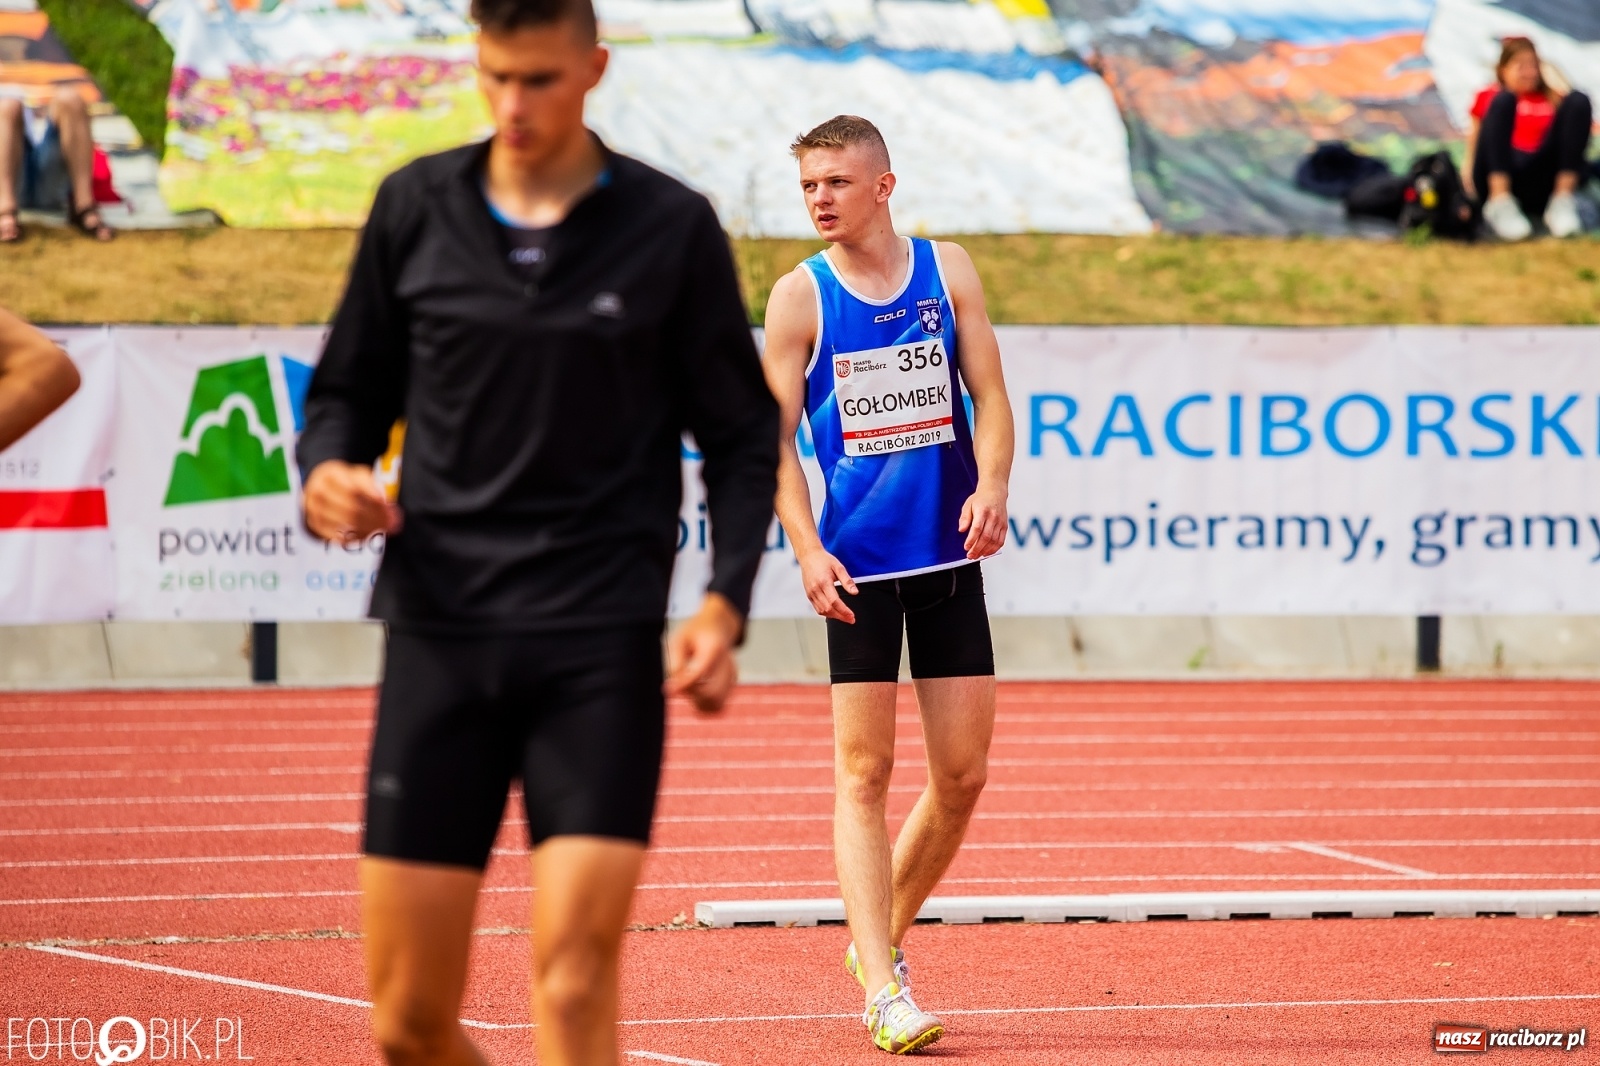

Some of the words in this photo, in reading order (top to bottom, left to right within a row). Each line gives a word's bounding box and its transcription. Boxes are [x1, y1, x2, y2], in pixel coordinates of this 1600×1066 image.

[874, 308, 907, 323] COLO
[916, 298, 938, 307] MMKS
[853, 362, 887, 373] Racibórz
[897, 344, 943, 372] 356
[843, 384, 948, 417] GOŁOMBEK
[1028, 393, 1600, 459] RACIBORSK
[858, 435, 916, 453] RACIBÓRZ
[919, 430, 941, 444] 2019
[158, 518, 296, 562] powiat
[1008, 502, 1387, 564] wspieramy,
[159, 567, 280, 593] zielona
